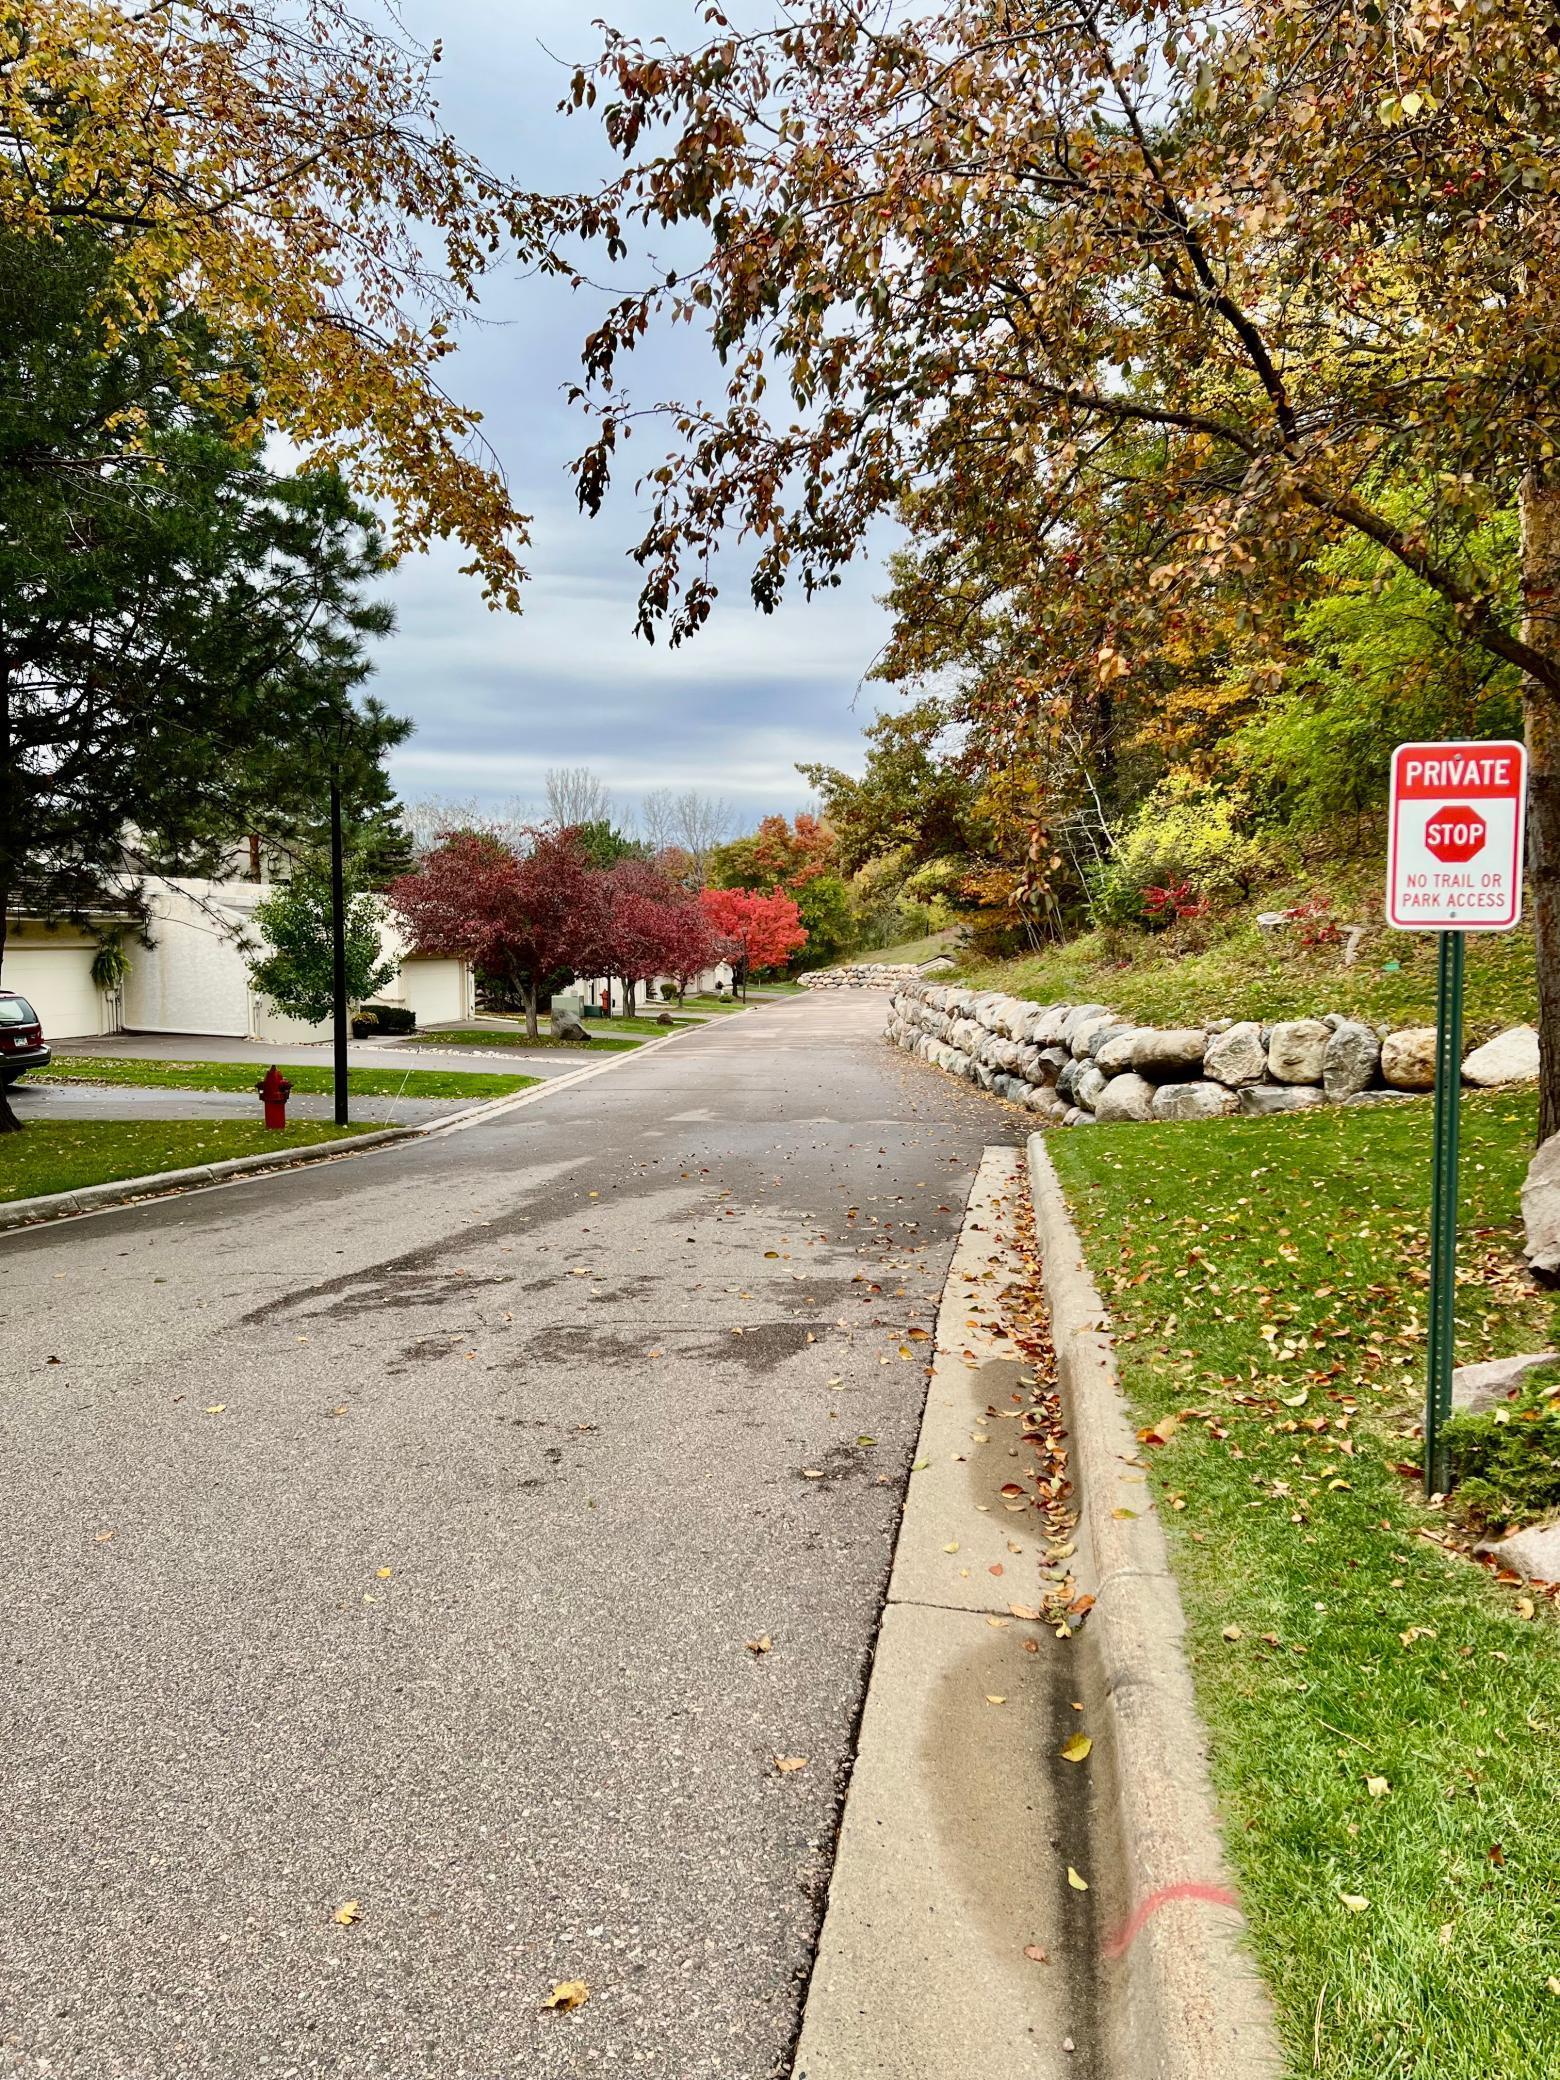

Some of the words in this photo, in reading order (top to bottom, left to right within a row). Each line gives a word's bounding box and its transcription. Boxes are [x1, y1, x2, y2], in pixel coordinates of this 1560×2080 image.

[1405, 759, 1511, 787] PRIVATE
[1427, 824, 1484, 845] STOP
[1407, 874, 1427, 888] NO
[1433, 874, 1474, 888] TRAIL
[1481, 873, 1502, 887] OR
[1402, 893, 1440, 908] PARK
[1446, 893, 1505, 907] ACCESS
